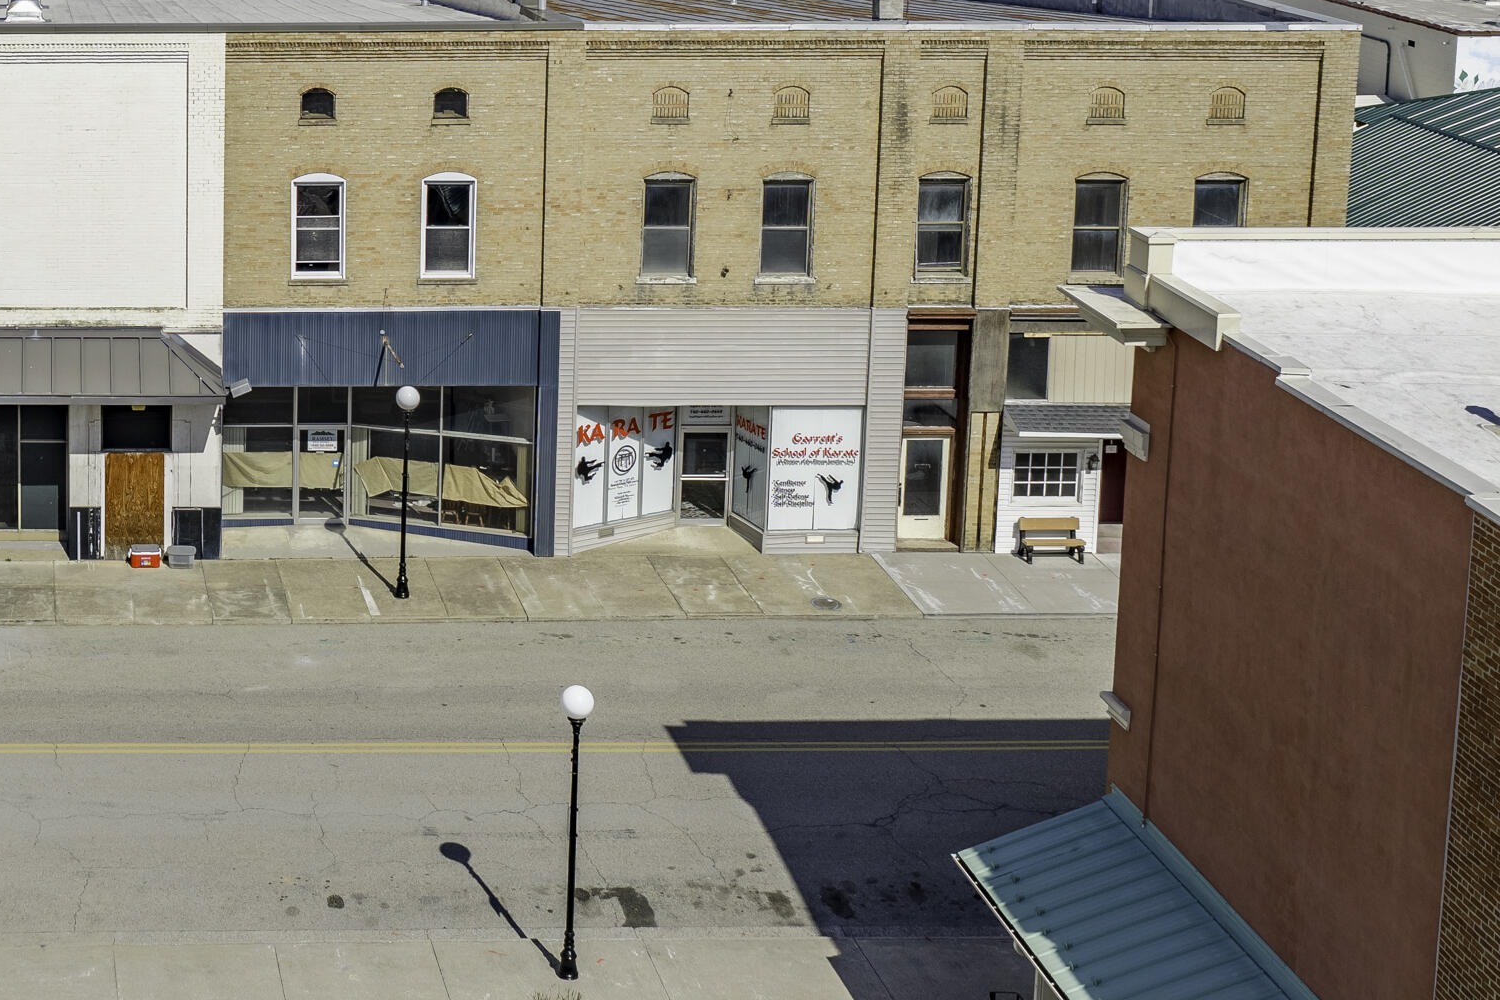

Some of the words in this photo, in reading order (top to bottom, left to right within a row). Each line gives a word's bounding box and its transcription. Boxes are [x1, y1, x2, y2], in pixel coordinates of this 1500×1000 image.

[736, 415, 766, 440] KARATE
[792, 432, 843, 443] Garrett's
[772, 447, 807, 458] School
[809, 447, 822, 458] of
[823, 447, 859, 458] Karate
